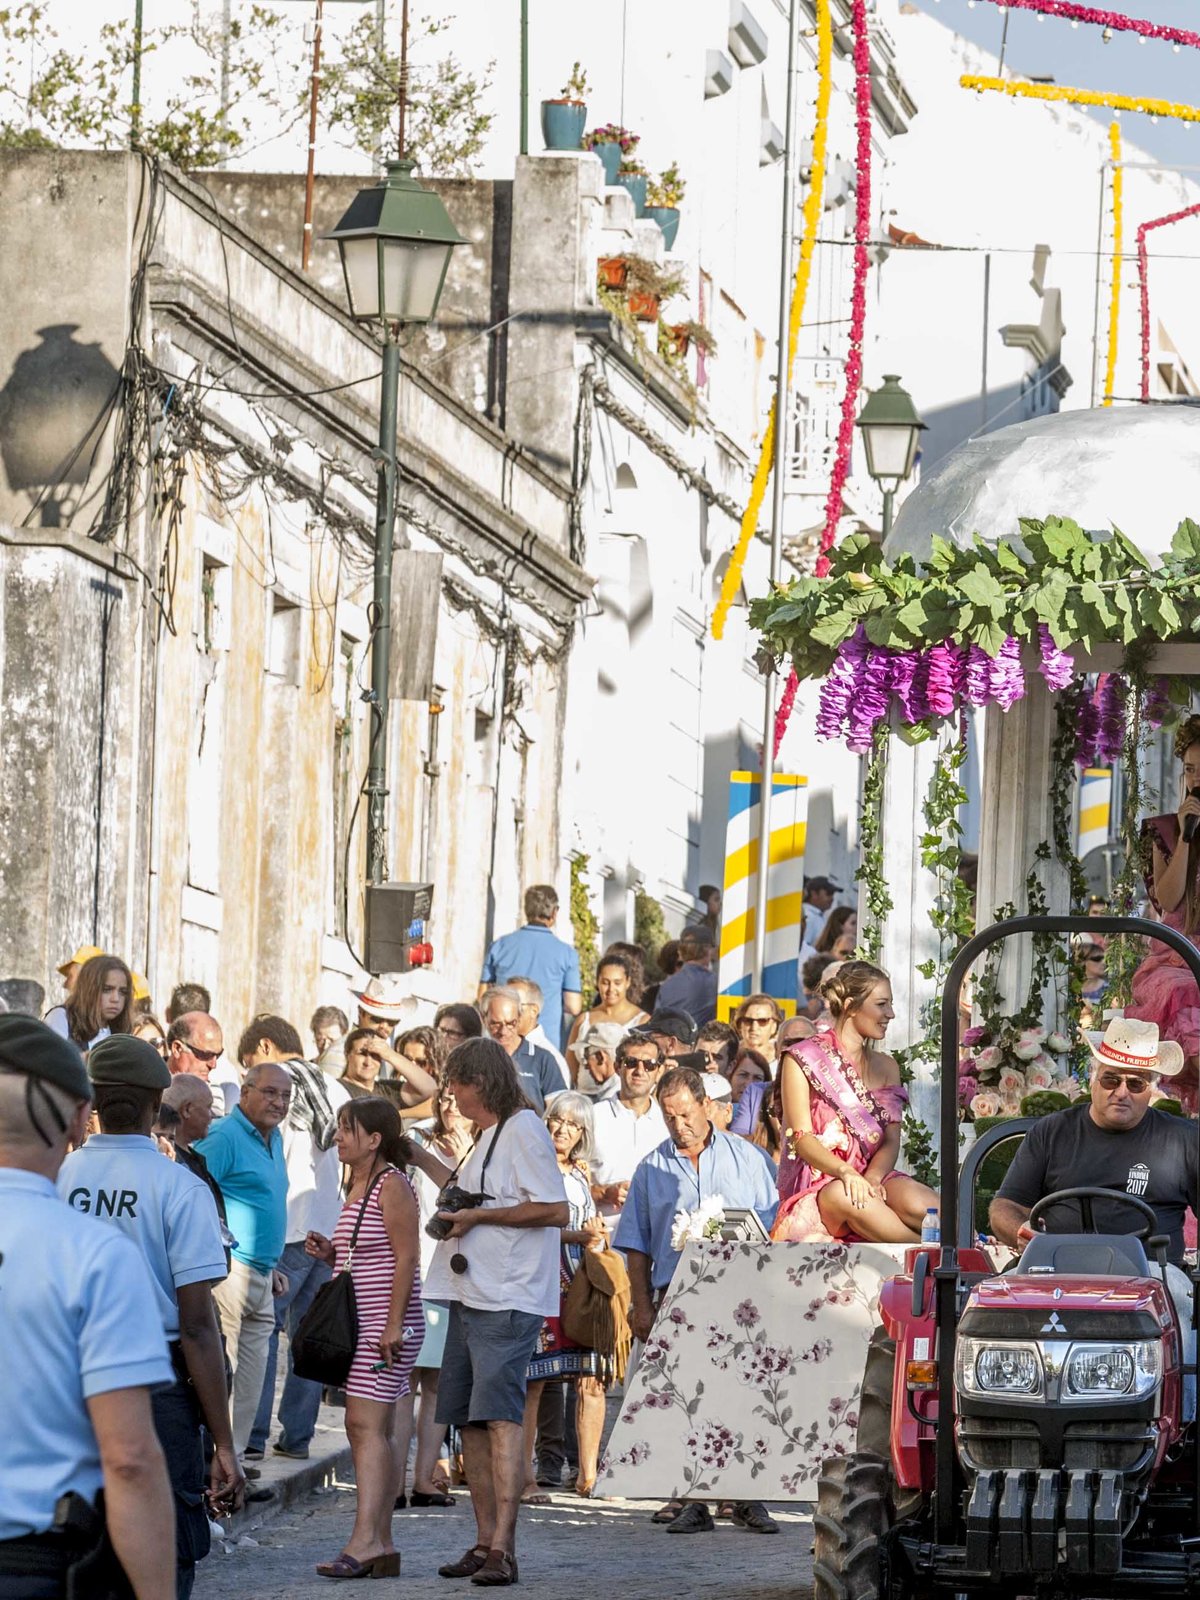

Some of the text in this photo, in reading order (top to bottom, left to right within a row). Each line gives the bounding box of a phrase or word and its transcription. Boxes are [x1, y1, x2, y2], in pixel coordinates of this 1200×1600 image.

[820, 1066, 841, 1092] Dama
[1126, 1179, 1148, 1195] 2017
[68, 1187, 138, 1218] GNR
